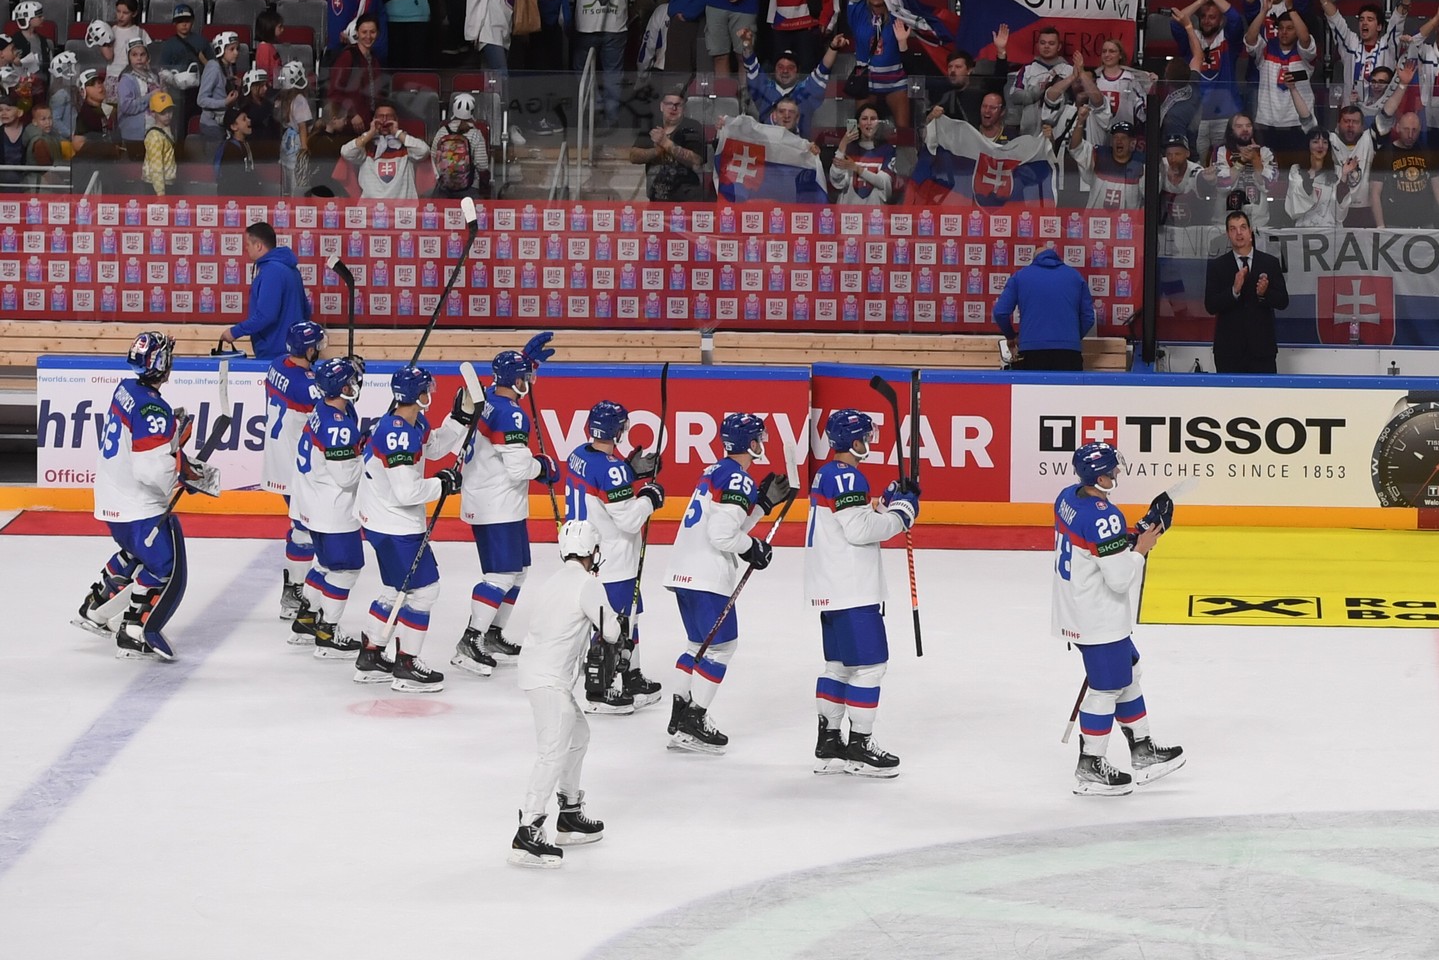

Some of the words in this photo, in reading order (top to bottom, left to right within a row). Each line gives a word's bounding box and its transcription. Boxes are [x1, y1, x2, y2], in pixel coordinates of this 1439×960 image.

[511, 411, 524, 430] 3
[327, 426, 351, 446] 79
[386, 431, 410, 451] 64
[1125, 415, 1346, 455] TISSOT
[608, 464, 629, 486] 91
[834, 471, 856, 494] 17
[1228, 464, 1290, 479] SINCE
[1303, 465, 1346, 480] 1853
[728, 473, 754, 496] 25
[1094, 514, 1123, 539] 28
